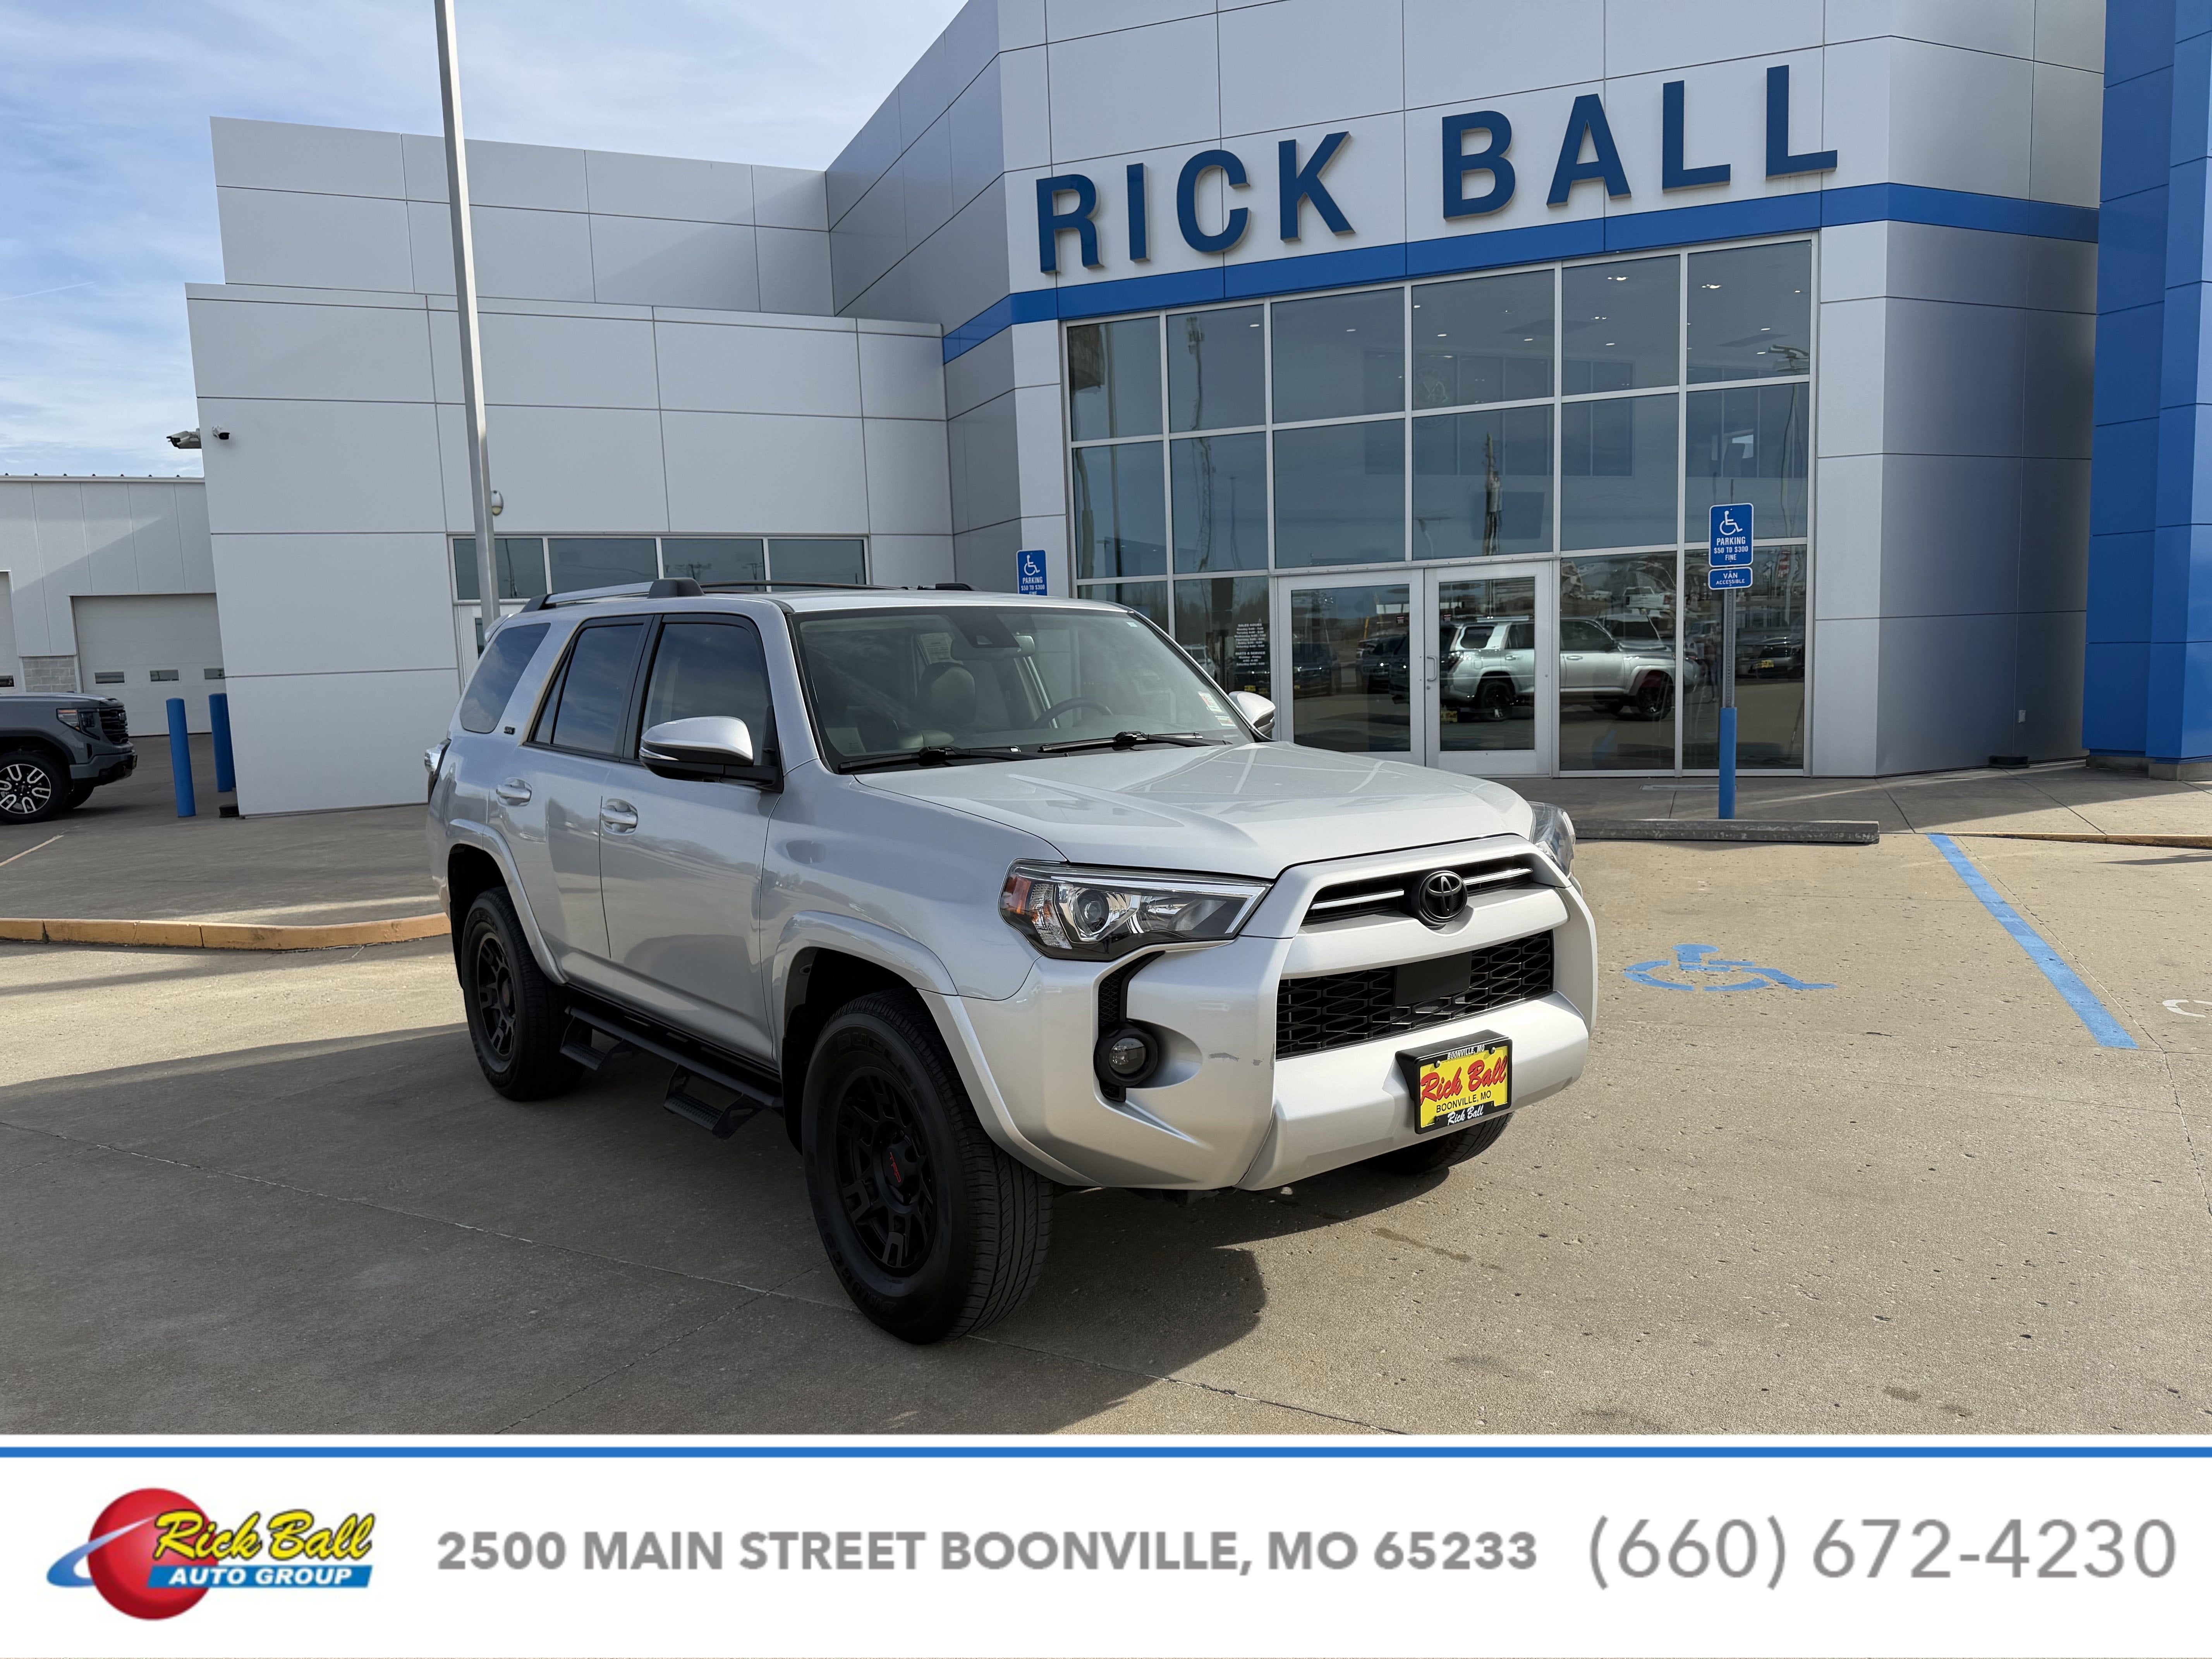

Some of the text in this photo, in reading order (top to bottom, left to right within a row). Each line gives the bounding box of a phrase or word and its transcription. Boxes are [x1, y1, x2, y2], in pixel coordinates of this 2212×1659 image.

[1036, 65, 1838, 273] RICK BALL
[1716, 536, 1746, 546] PARKING
[1022, 576, 1043, 584] PARKING
[1447, 1044, 1485, 1060] BOONVILLE, MO
[1420, 1055, 1508, 1106] Rick Ball
[1436, 1090, 1491, 1113] BOONVILLE, MO
[1447, 1104, 1484, 1126] Rick Ball
